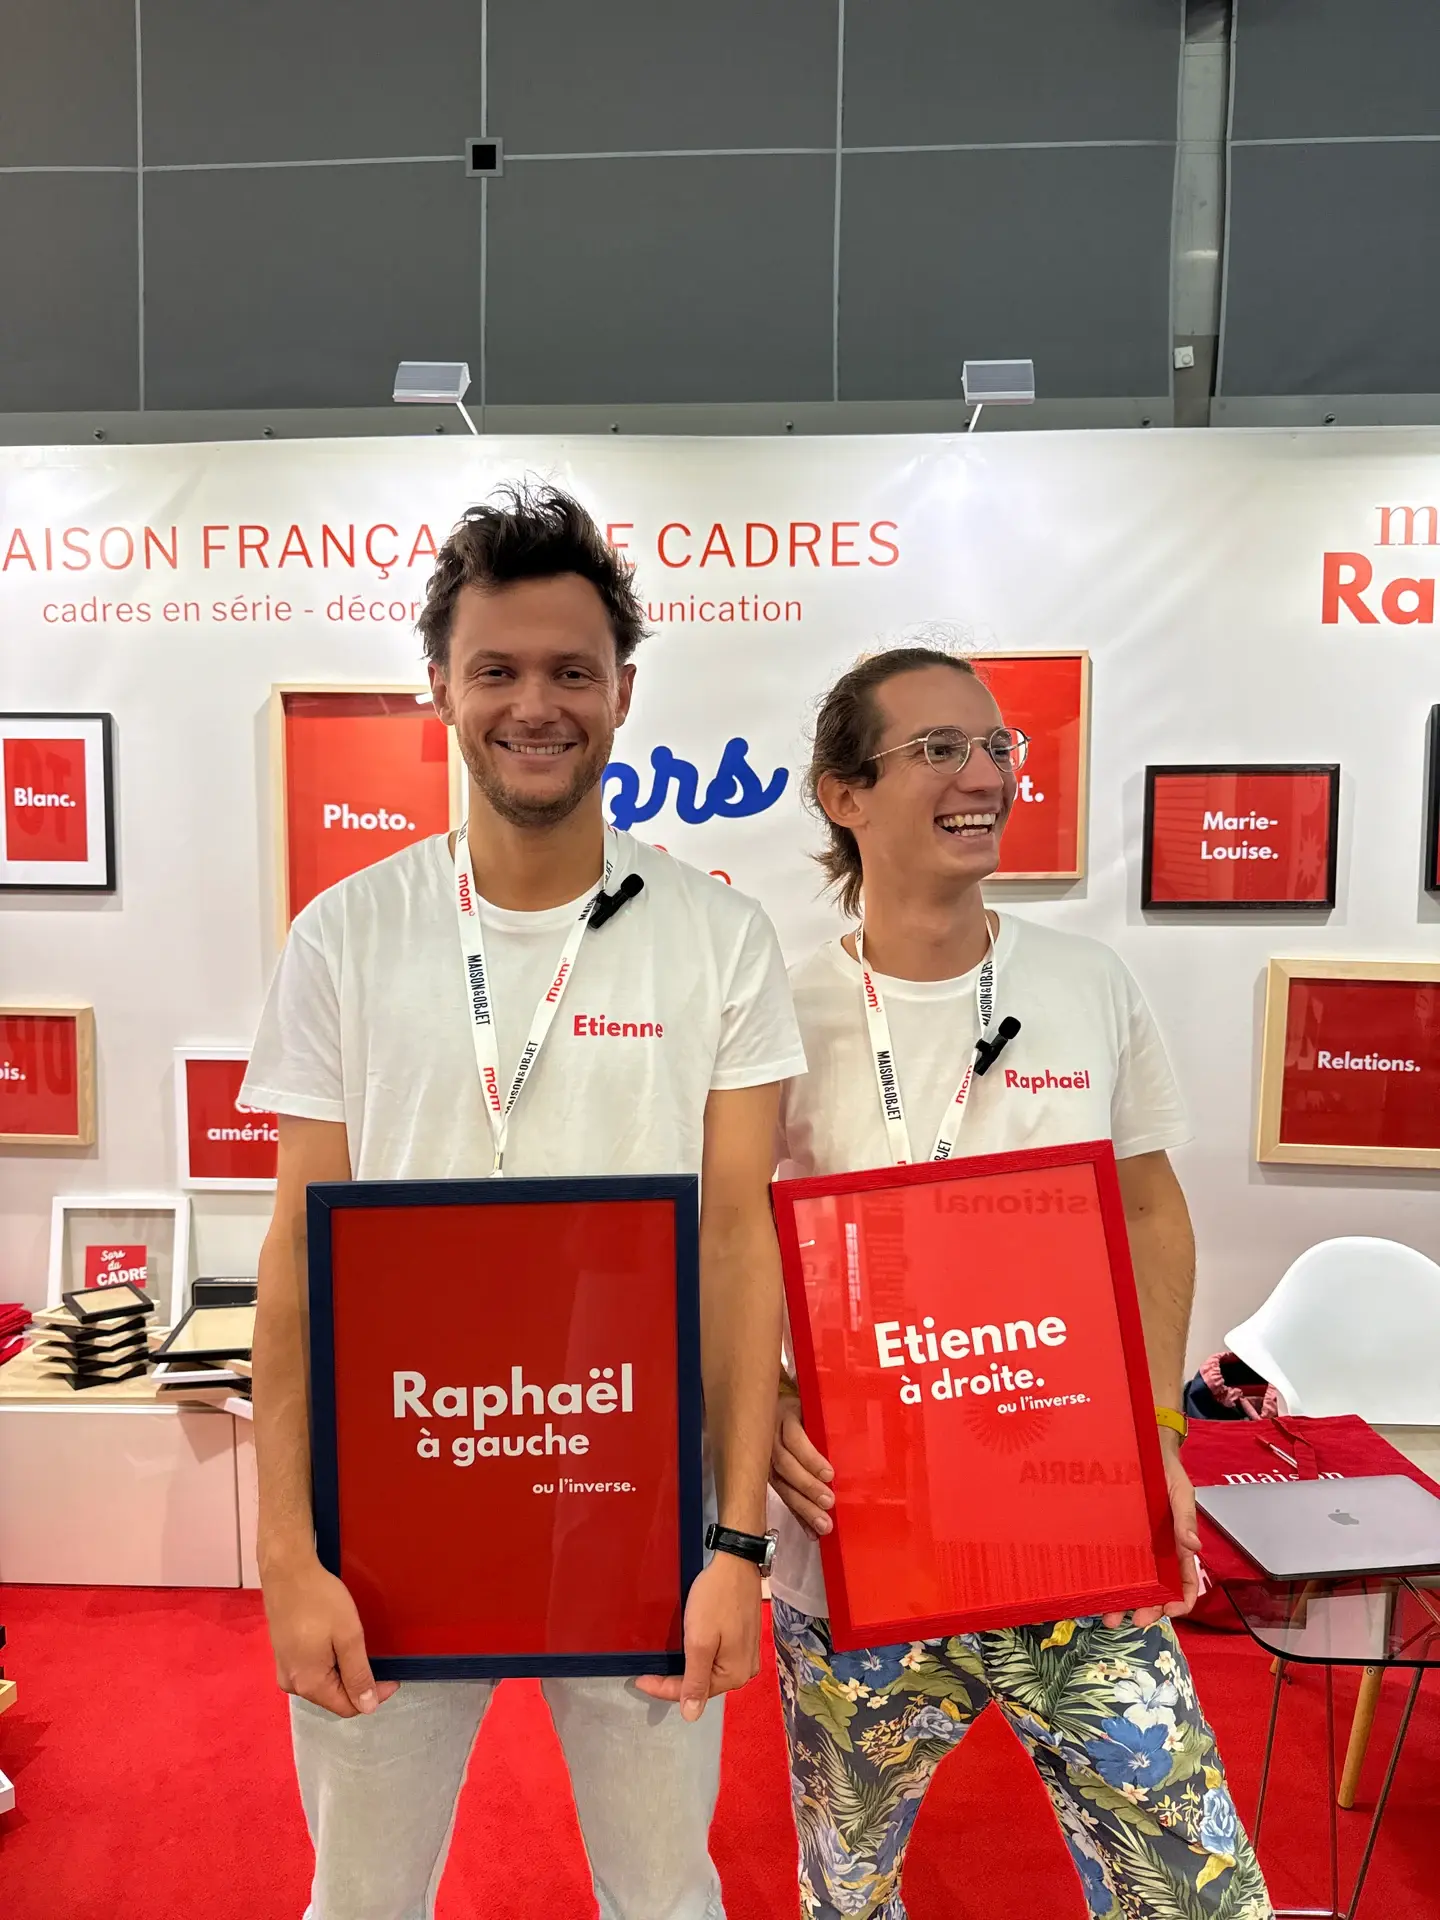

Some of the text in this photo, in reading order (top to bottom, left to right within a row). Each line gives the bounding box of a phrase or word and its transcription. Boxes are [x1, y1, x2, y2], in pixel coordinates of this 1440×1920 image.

[657, 520, 900, 569] CADRES
[1322, 551, 1436, 625] Ra
[43, 597, 151, 623] cadres
[163, 601, 200, 622] en
[212, 595, 292, 622] série
[327, 595, 420, 622] décor
[641, 594, 802, 623] unication
[13, 787, 77, 807] Blanc.
[323, 803, 416, 831] Photo.
[1203, 811, 1278, 830] Marie-
[1201, 840, 1278, 860] Louise.
[458, 873, 473, 912] mom
[467, 954, 491, 1026] MAISON&OBJET
[545, 961, 571, 1003] mom
[573, 1014, 664, 1038] Etienne
[1317, 1050, 1421, 1073] Relations.
[877, 1050, 902, 1121] MAISON&OBJET
[1004, 1069, 1090, 1094] Raphaël
[96, 1266, 148, 1286] CADRE
[874, 1314, 1068, 1369] Etienne
[392, 1362, 634, 1431] Raphaël
[899, 1362, 1046, 1405] à droite.
[997, 1393, 1092, 1415] ou l’inverse.
[416, 1421, 590, 1467] à gauche
[532, 1477, 637, 1495] ou l’inverse.
